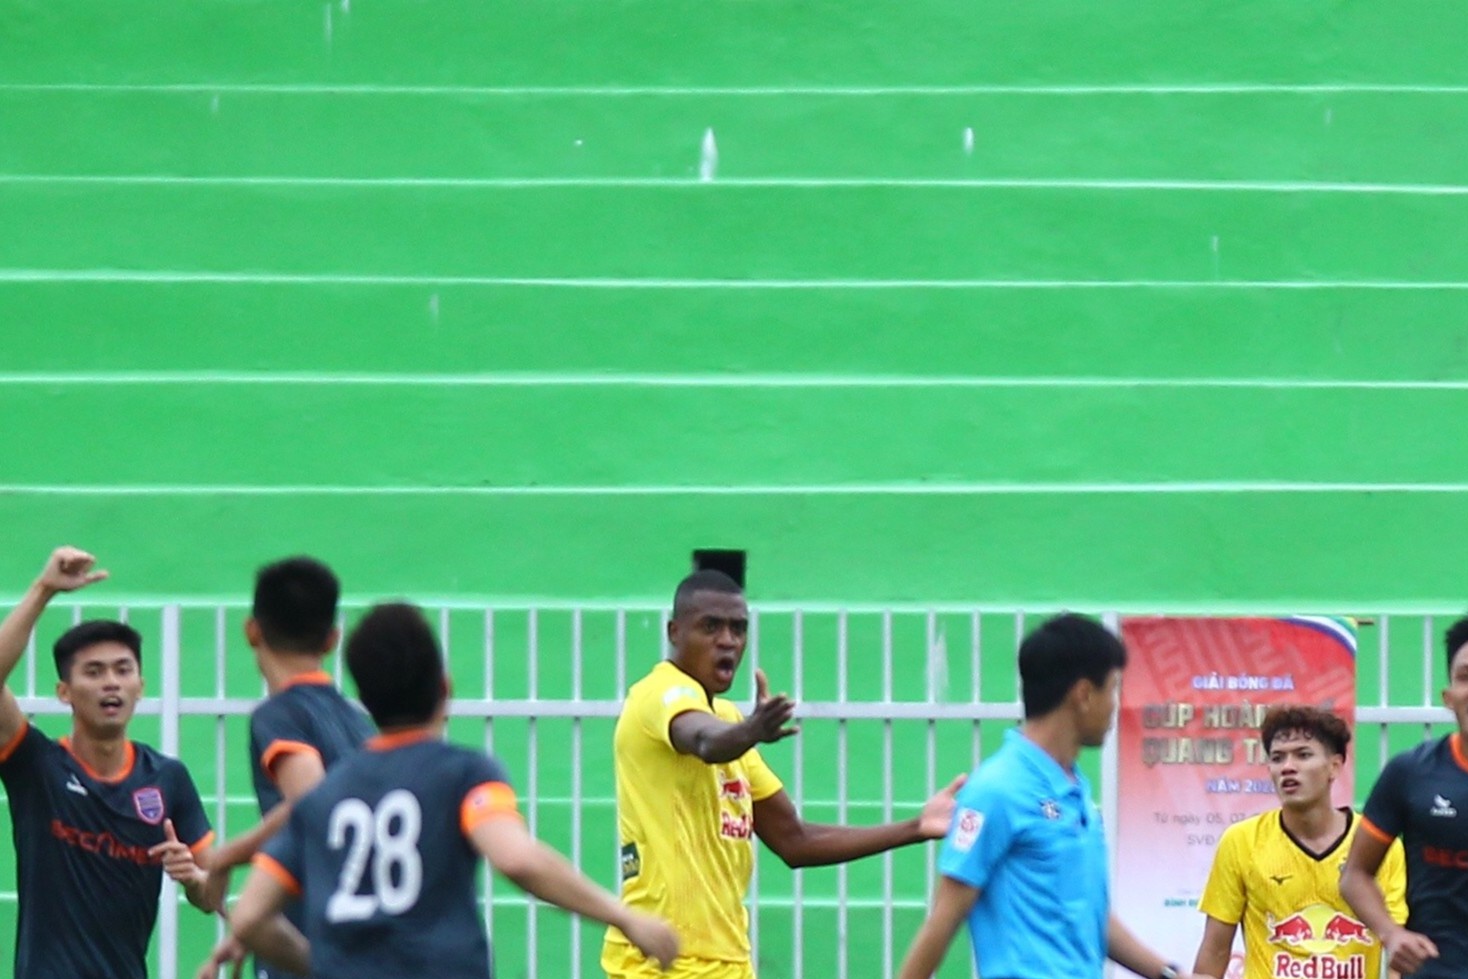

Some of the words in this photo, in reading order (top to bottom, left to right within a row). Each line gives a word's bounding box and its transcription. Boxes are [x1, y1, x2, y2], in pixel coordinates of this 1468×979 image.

[326, 789, 422, 923] 28
[1276, 953, 1318, 979] Red
[1321, 956, 1363, 979] Bull
